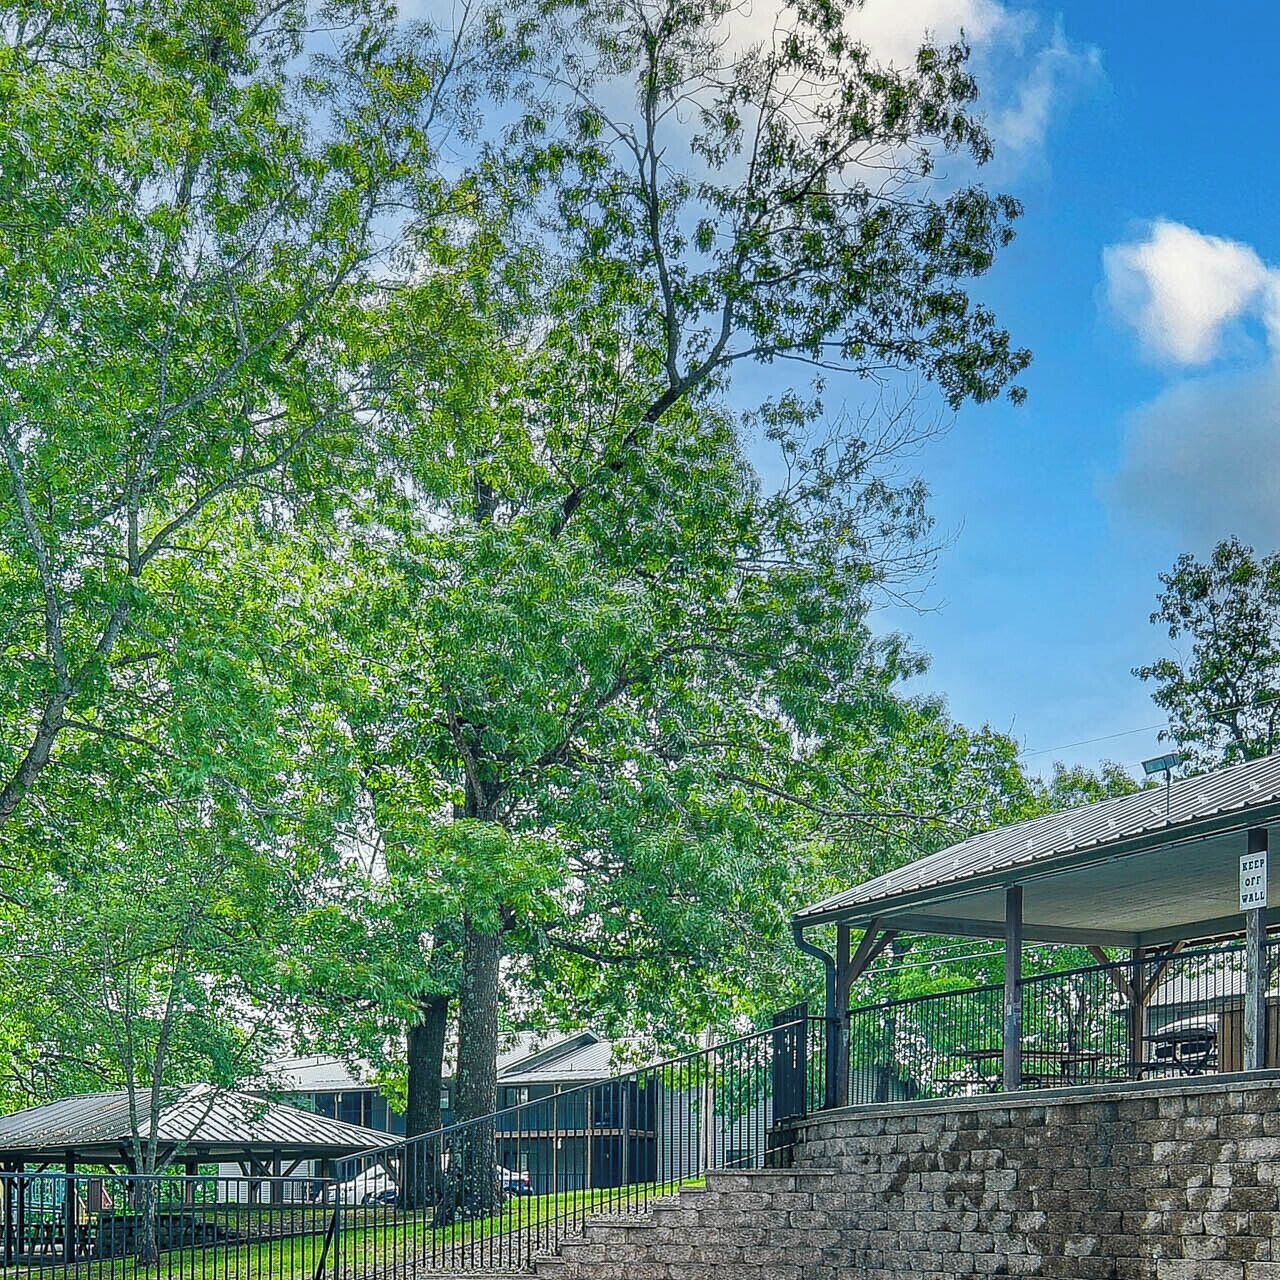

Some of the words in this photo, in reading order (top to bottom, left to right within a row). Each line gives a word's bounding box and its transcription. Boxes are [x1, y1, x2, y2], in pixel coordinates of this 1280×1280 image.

[1242, 859, 1265, 872] KEEP
[1245, 876, 1262, 887] OFF
[1242, 891, 1265, 903] WALL
